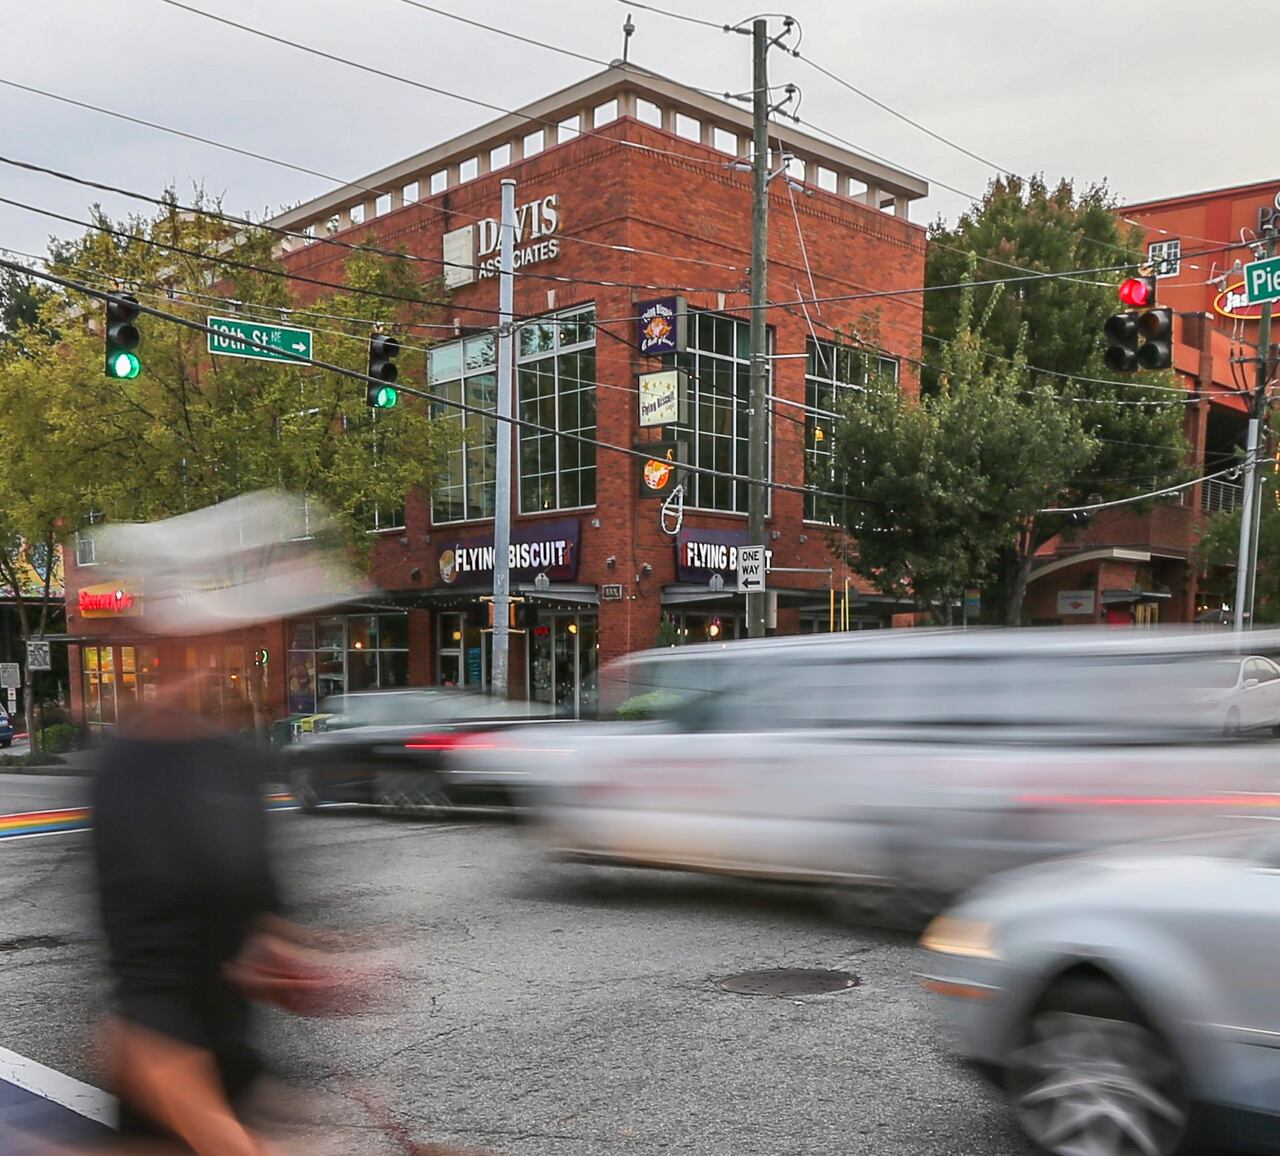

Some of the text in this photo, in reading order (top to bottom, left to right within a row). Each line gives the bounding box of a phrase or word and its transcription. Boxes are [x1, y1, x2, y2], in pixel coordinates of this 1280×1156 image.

[477, 194, 558, 256] DVIS
[478, 239, 560, 279] ASSCIATES
[213, 324, 245, 350] 10th
[252, 330, 268, 352] St
[455, 540, 566, 572] FLYIN BISCUIT
[686, 541, 728, 570] FLYING
[742, 551, 759, 561] ONE
[742, 565, 759, 575] WAY
